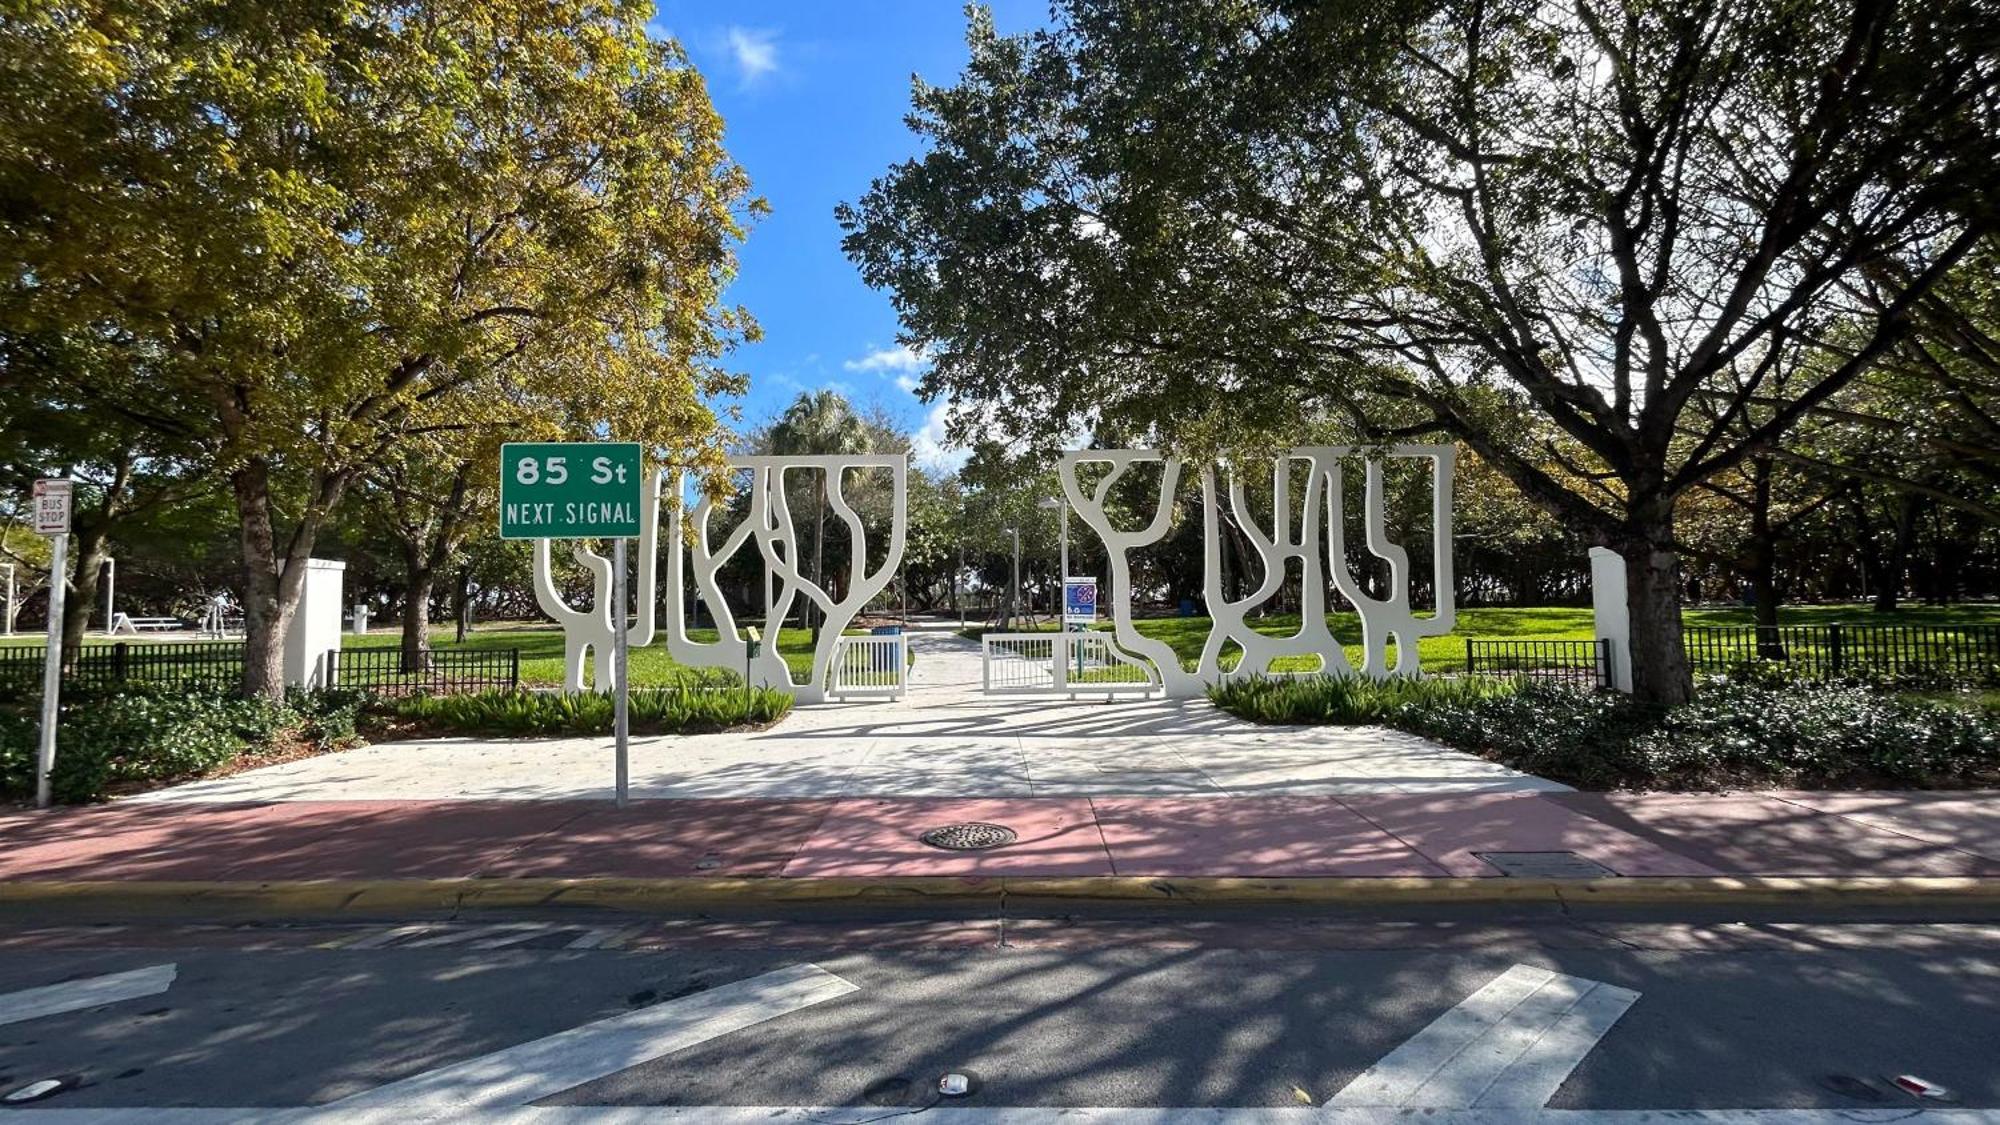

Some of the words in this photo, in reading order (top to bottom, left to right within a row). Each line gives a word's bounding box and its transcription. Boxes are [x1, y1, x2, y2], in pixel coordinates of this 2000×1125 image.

[516, 456, 568, 485] 85
[590, 456, 627, 485] St
[42, 499, 62, 510] BUS
[39, 511, 64, 522] STOP
[507, 503, 554, 525] NEXT
[566, 502, 636, 524] SIGNAL
